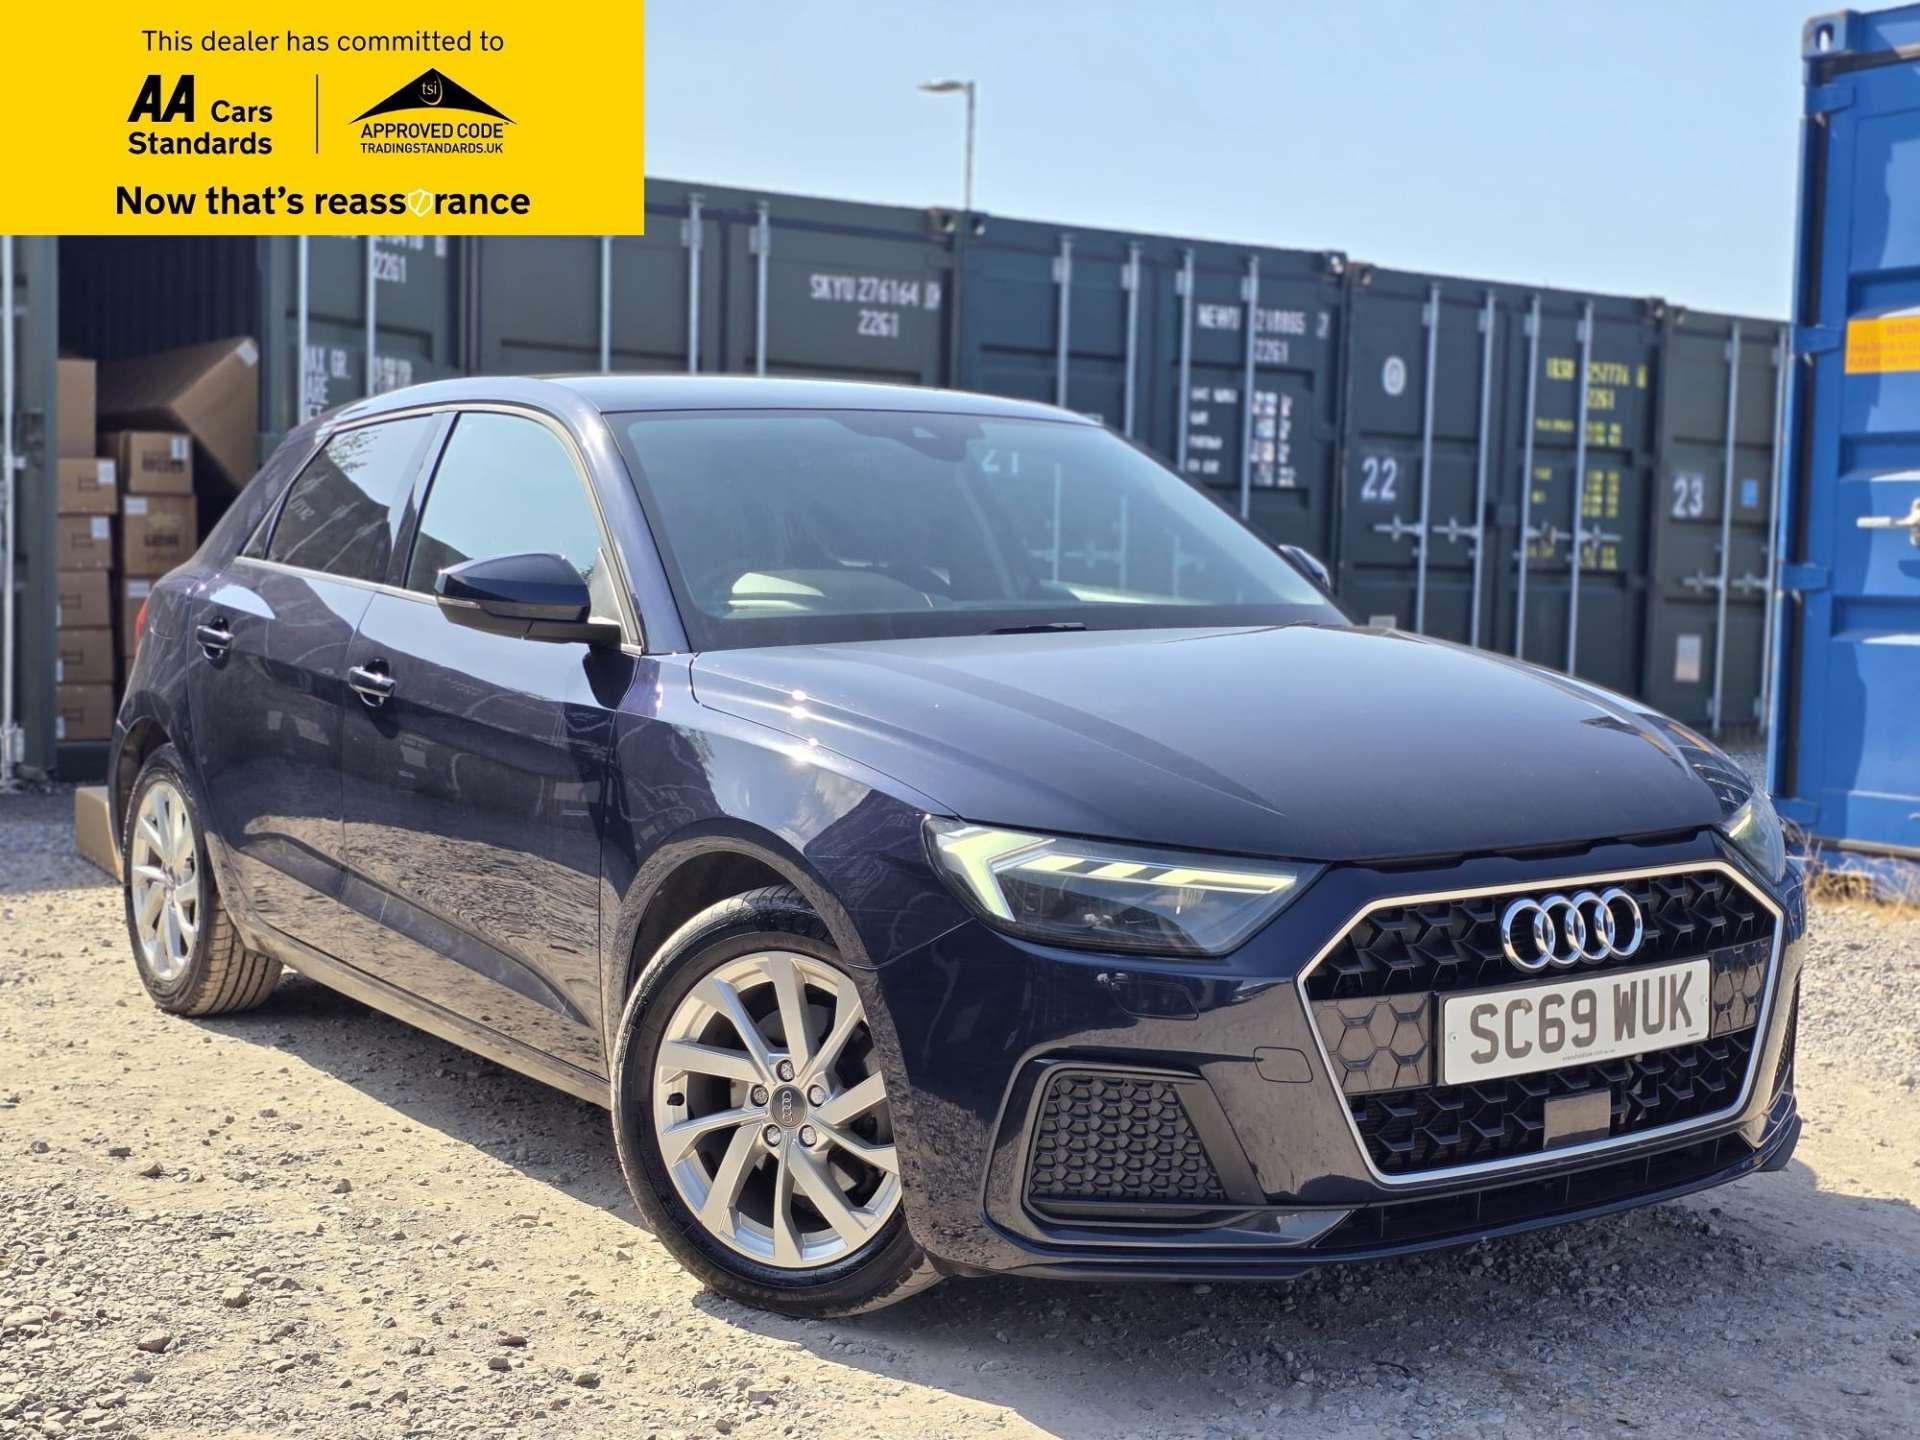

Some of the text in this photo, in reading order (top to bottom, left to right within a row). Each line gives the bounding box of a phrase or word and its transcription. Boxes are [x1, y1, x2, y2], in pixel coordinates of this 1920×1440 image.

[1361, 457, 1398, 500] 22
[1673, 477, 1703, 517] 23
[1469, 970, 1693, 1065] SC69 WUK
